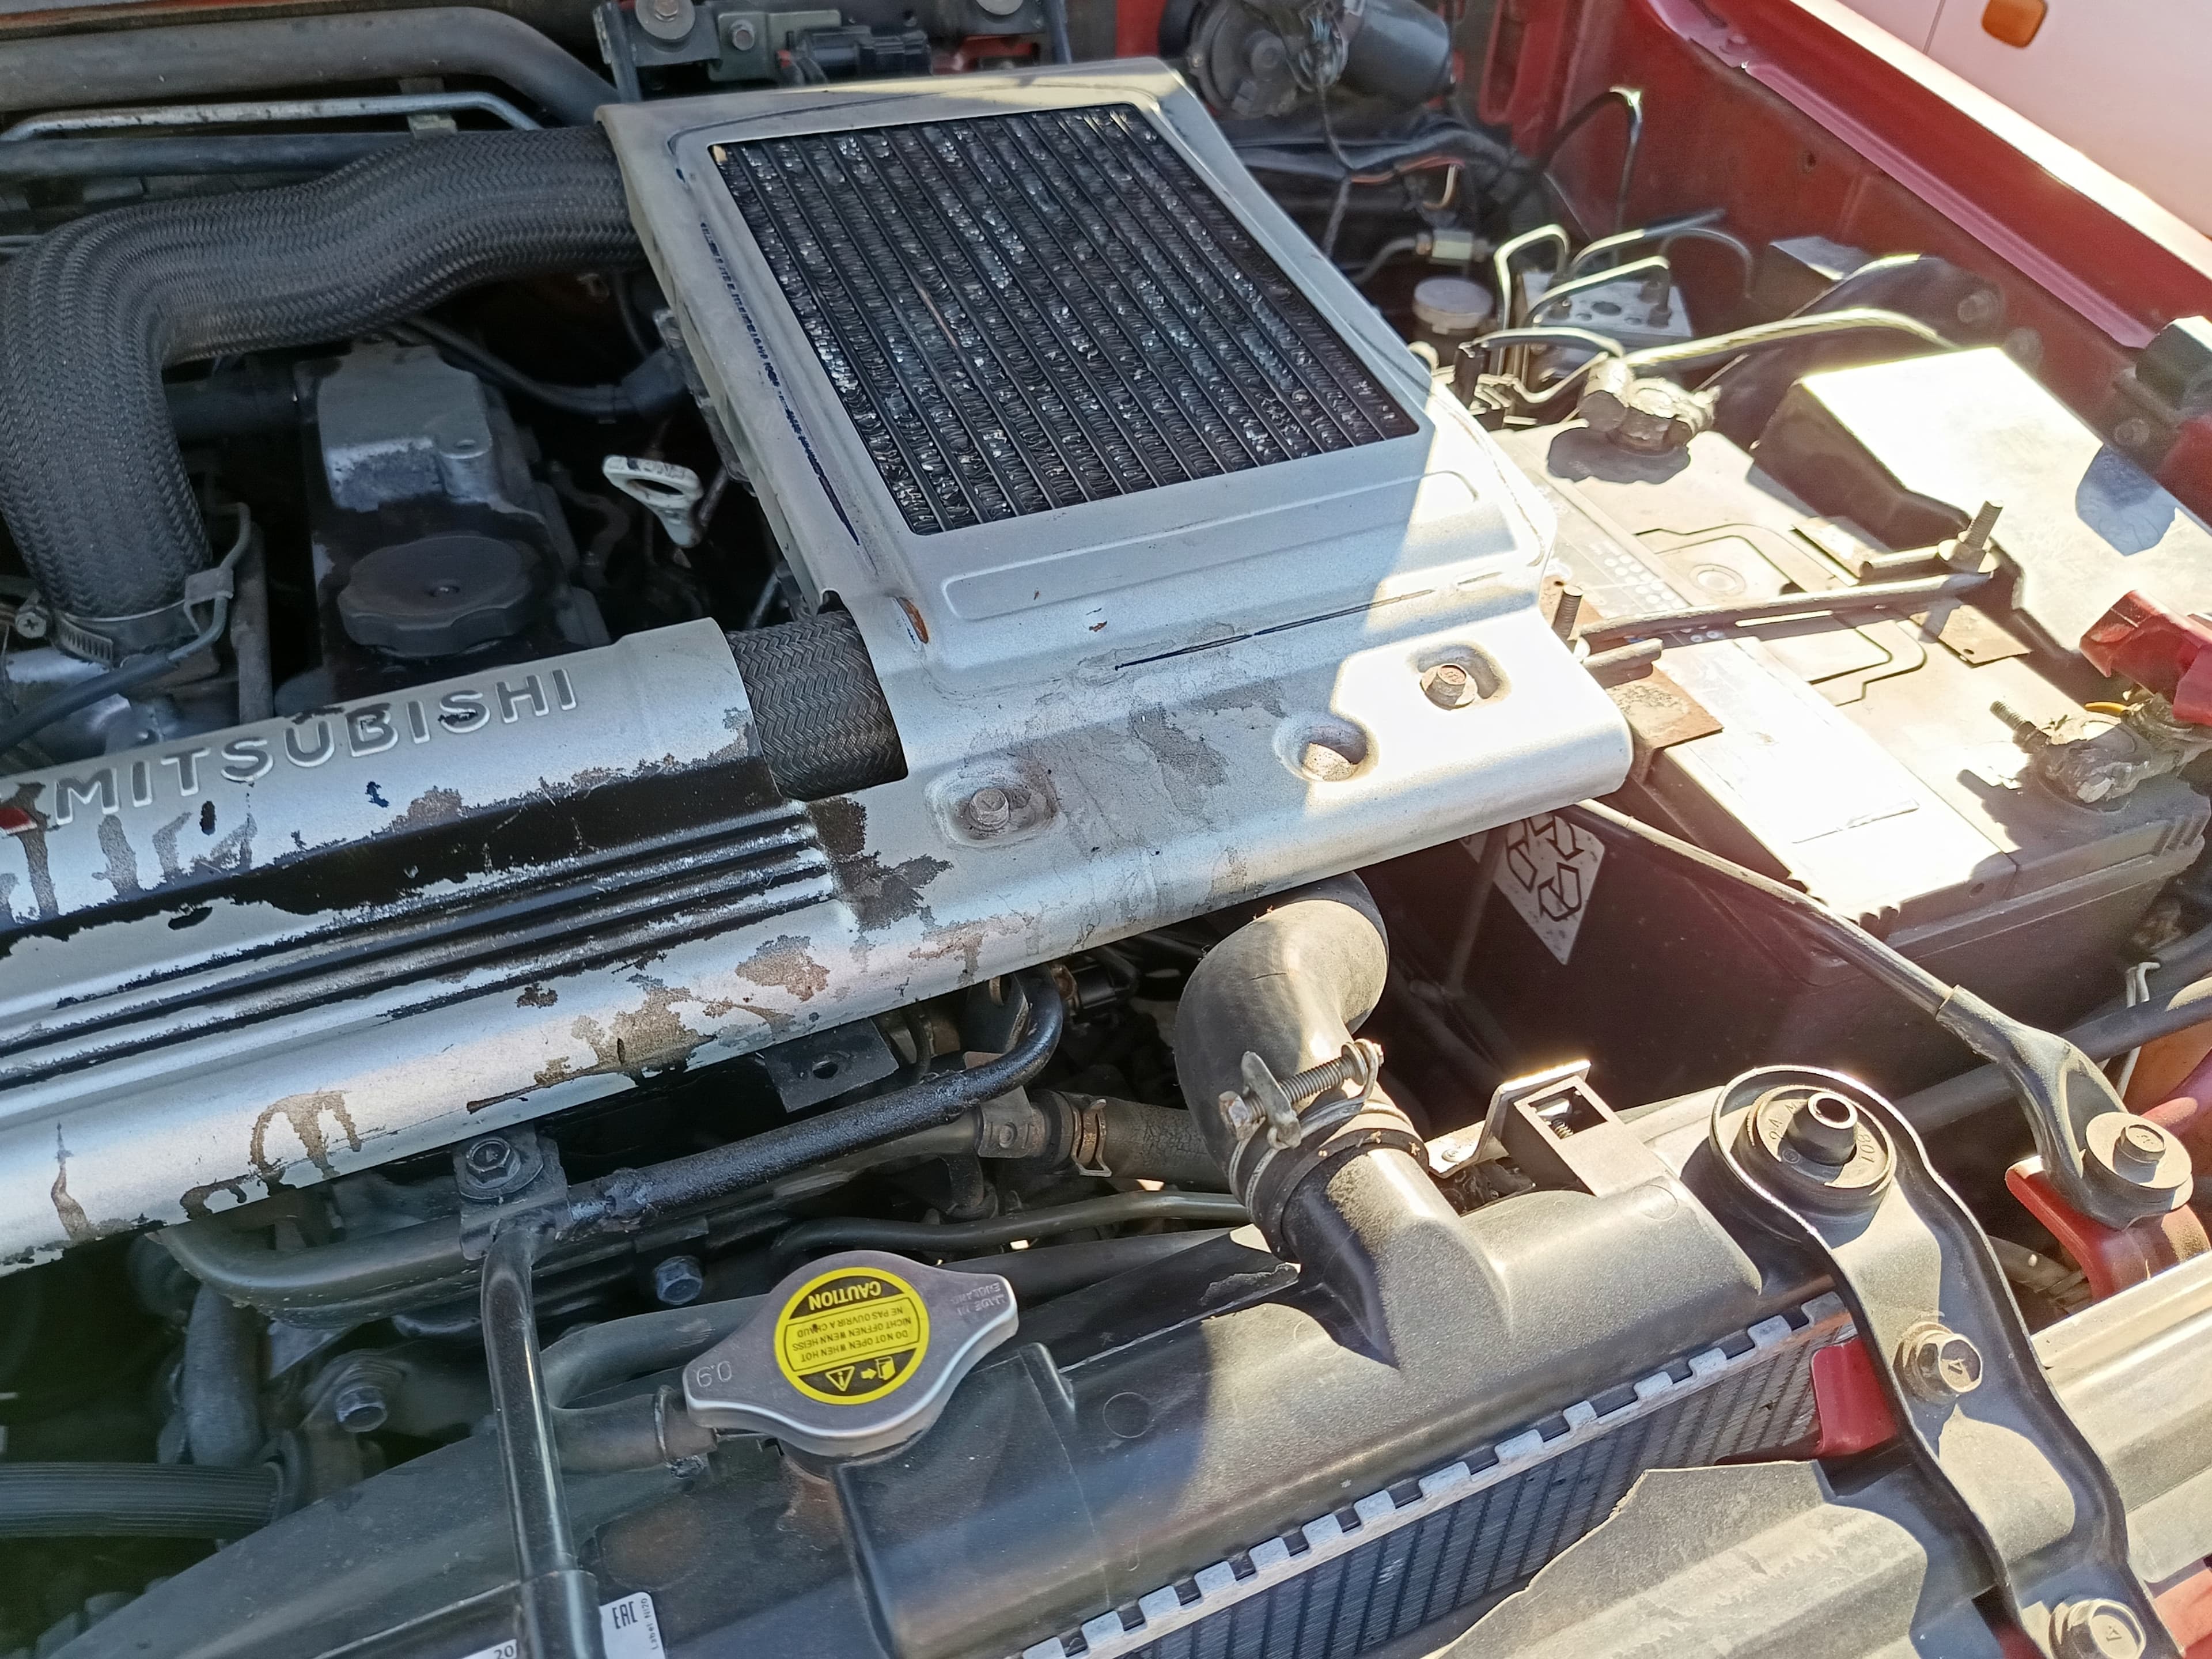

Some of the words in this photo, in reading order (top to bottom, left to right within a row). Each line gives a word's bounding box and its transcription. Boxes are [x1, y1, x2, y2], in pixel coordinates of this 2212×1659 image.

[54, 668, 578, 825] MITSUBISHI
[808, 1281, 882, 1311] CAUTION
[872, 1308, 889, 1319] PAS
[892, 1306, 904, 1315] NE
[838, 1313, 871, 1328] OUVRIR
[887, 1316, 912, 1330] NICHT
[797, 1323, 828, 1338] CHAUD
[820, 1331, 847, 1343] WENN
[896, 1330, 908, 1339] DO
[792, 1337, 819, 1351] HEISS
[849, 1337, 873, 1350] OPEN
[876, 1333, 893, 1344] NOT
[801, 1350, 819, 1363] HOT
[820, 1344, 847, 1357] WHEN
[612, 1601, 638, 1630] EAC
